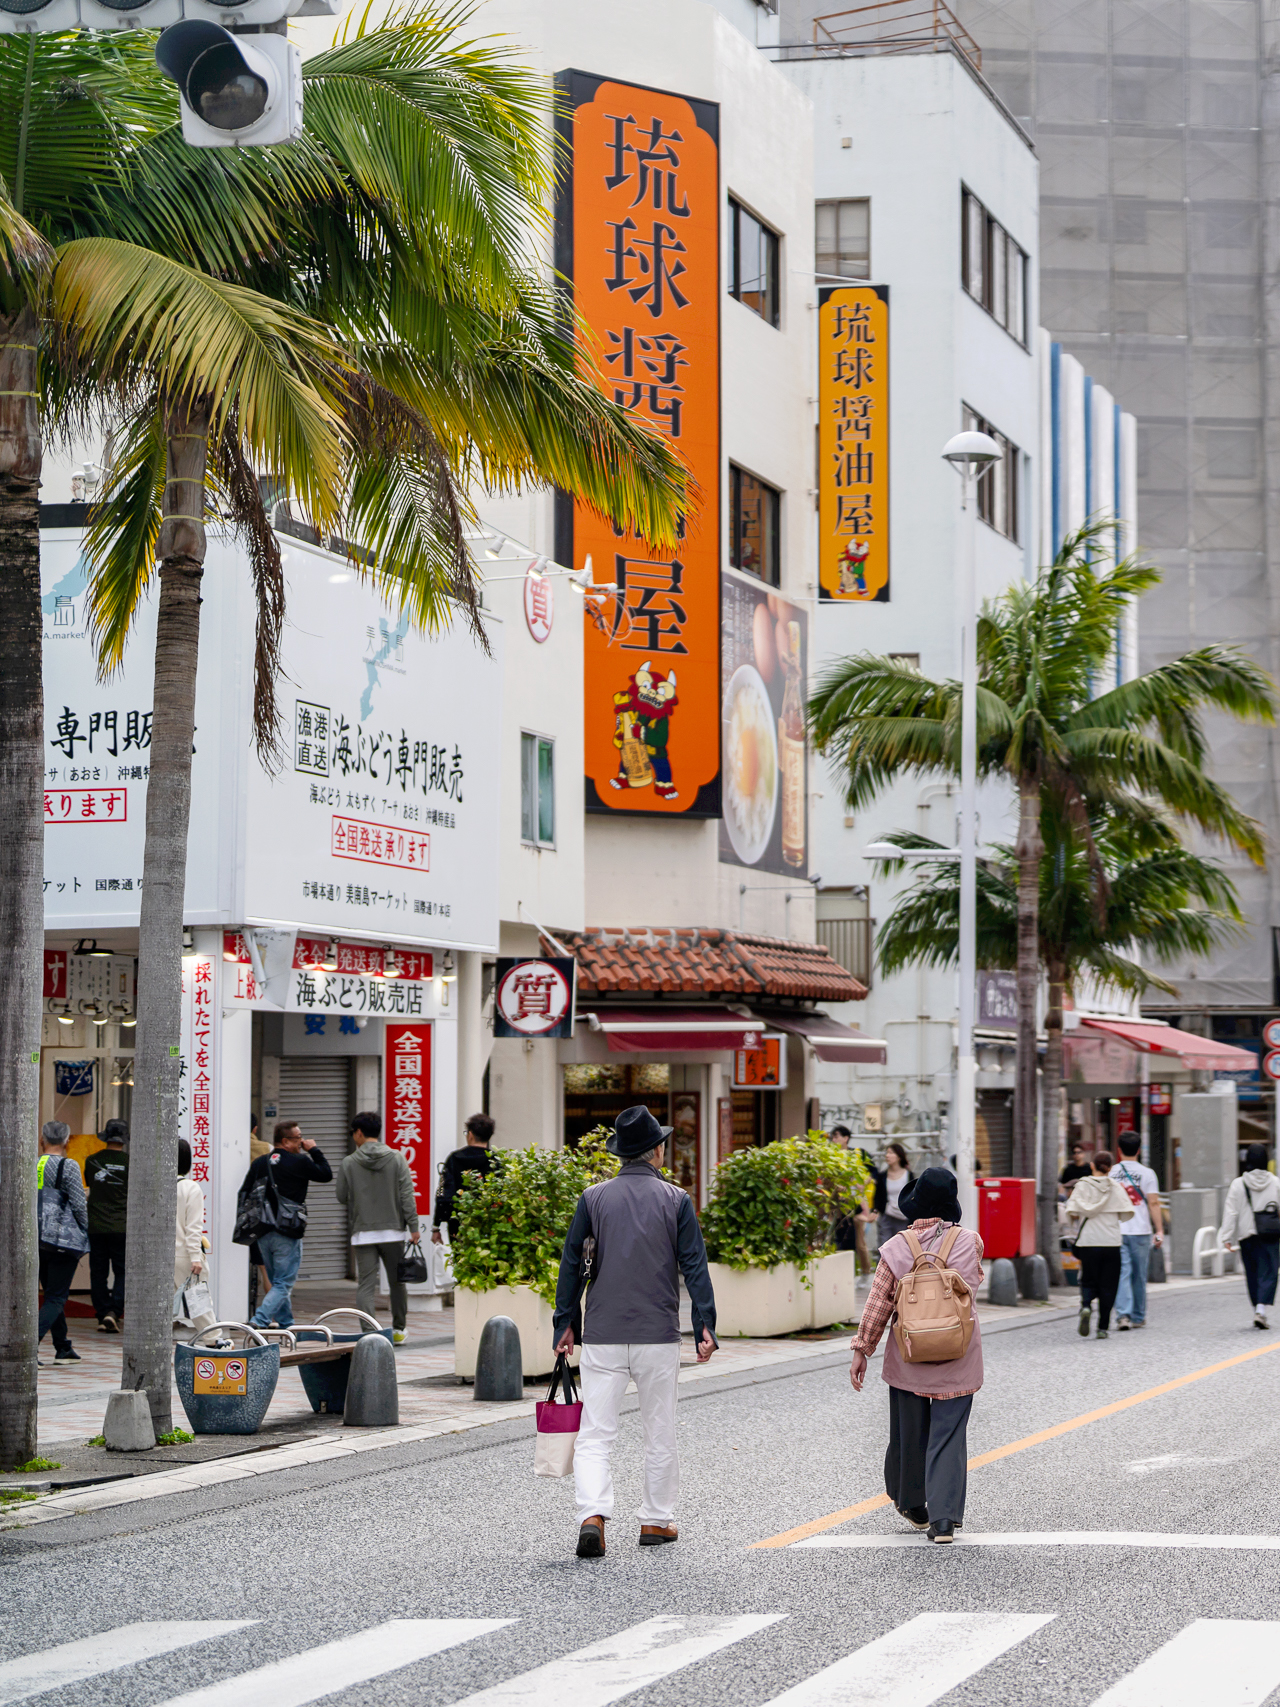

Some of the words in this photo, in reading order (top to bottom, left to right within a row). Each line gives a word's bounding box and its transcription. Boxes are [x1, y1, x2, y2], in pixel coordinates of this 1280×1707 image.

[603, 113, 692, 655] 琉球醤屋
[831, 302, 876, 537] 琉球醤油屋
[297, 708, 328, 741] 漁港
[297, 740, 328, 771] 直送
[332, 713, 464, 803] 海ぶどう専門販売
[334, 821, 428, 866] 全国発送承ります
[296, 972, 423, 1014] 海ぶどう販売店
[511, 972, 558, 1022] 質
